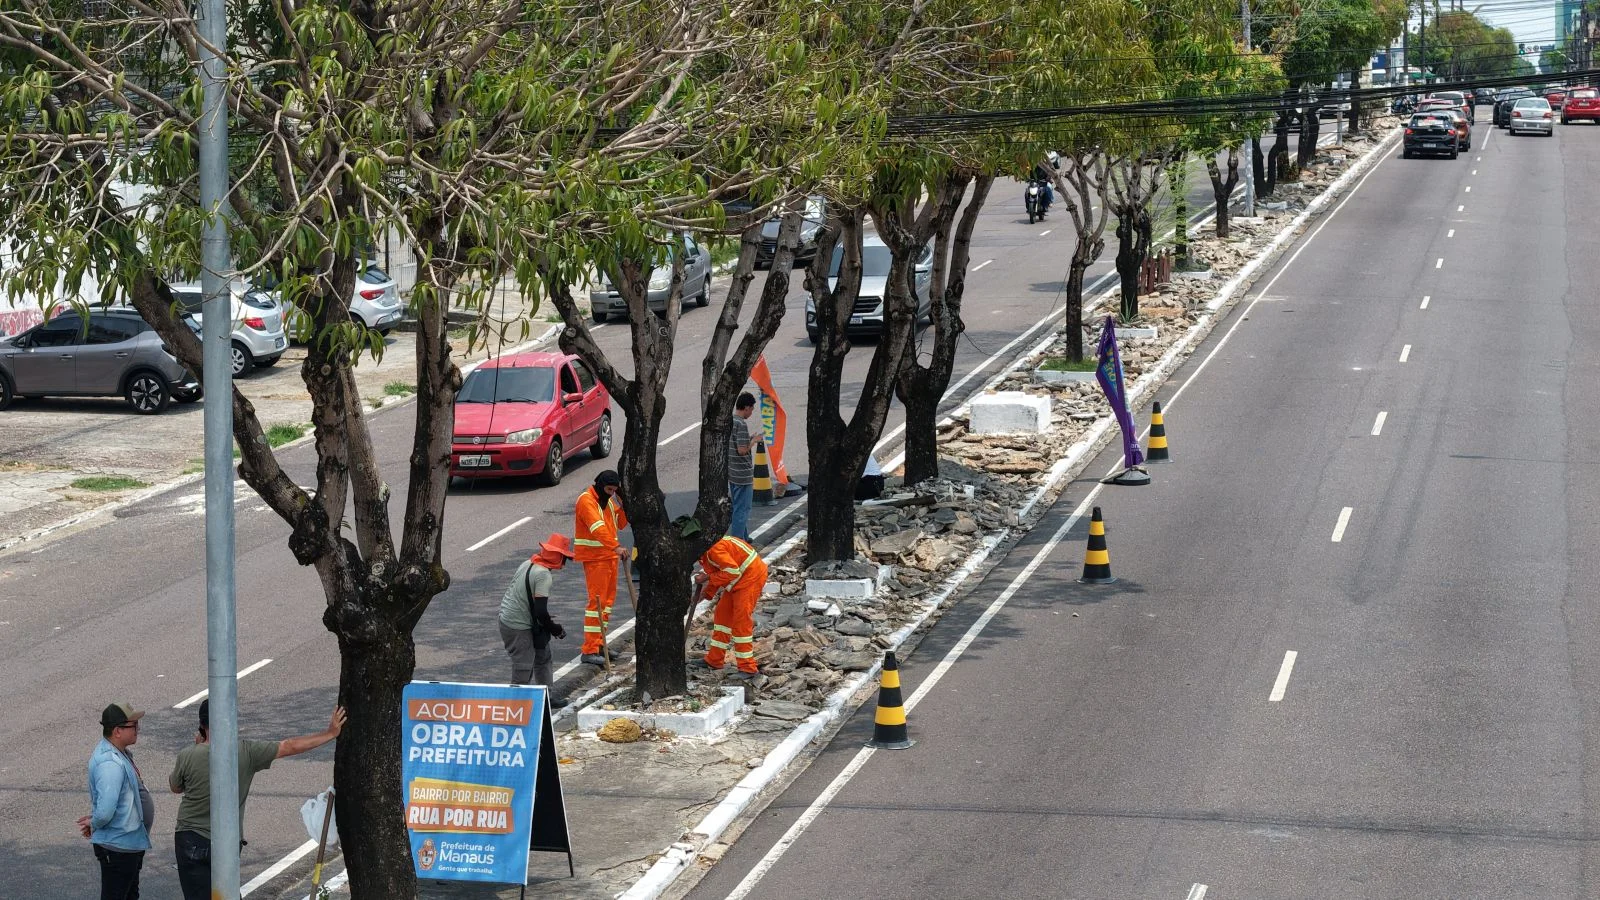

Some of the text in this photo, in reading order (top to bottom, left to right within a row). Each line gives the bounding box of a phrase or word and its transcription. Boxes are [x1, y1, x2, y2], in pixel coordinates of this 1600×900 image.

[416, 702, 524, 722] AQUI TEM
[411, 723, 527, 749] OBRA DA
[409, 747, 525, 767] PREFEITURA
[413, 787, 509, 805] BAIRRO POR BAIRRO
[409, 806, 508, 829] RUA POR RUA
[439, 848, 495, 865] Manaus
[441, 841, 495, 852] Prefeitura de
